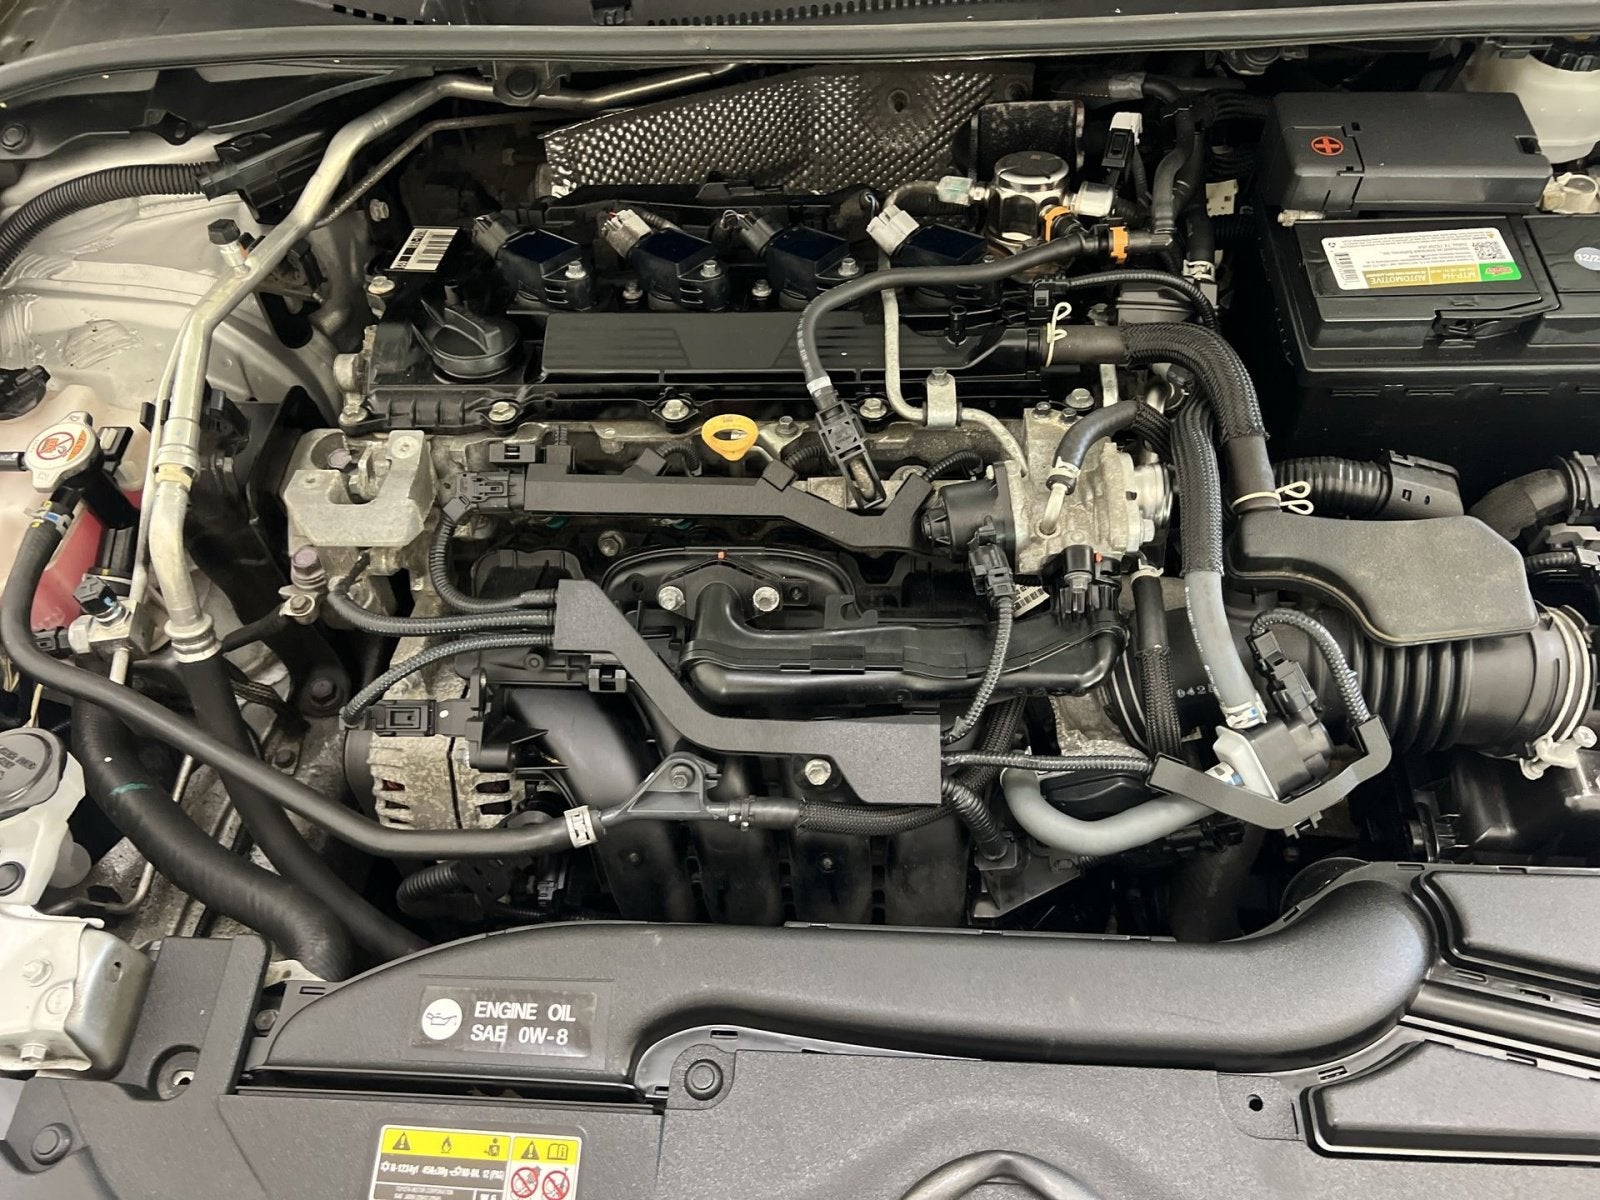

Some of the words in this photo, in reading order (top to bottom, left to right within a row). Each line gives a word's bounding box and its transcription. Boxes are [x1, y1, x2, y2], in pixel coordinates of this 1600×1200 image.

[1370, 274, 1426, 285] AUTOMOTIVE
[474, 1000, 539, 1021] ENGINE
[547, 1003, 576, 1022] OIL
[470, 1024, 508, 1042] SAE
[518, 1028, 569, 1046] 0W-8
